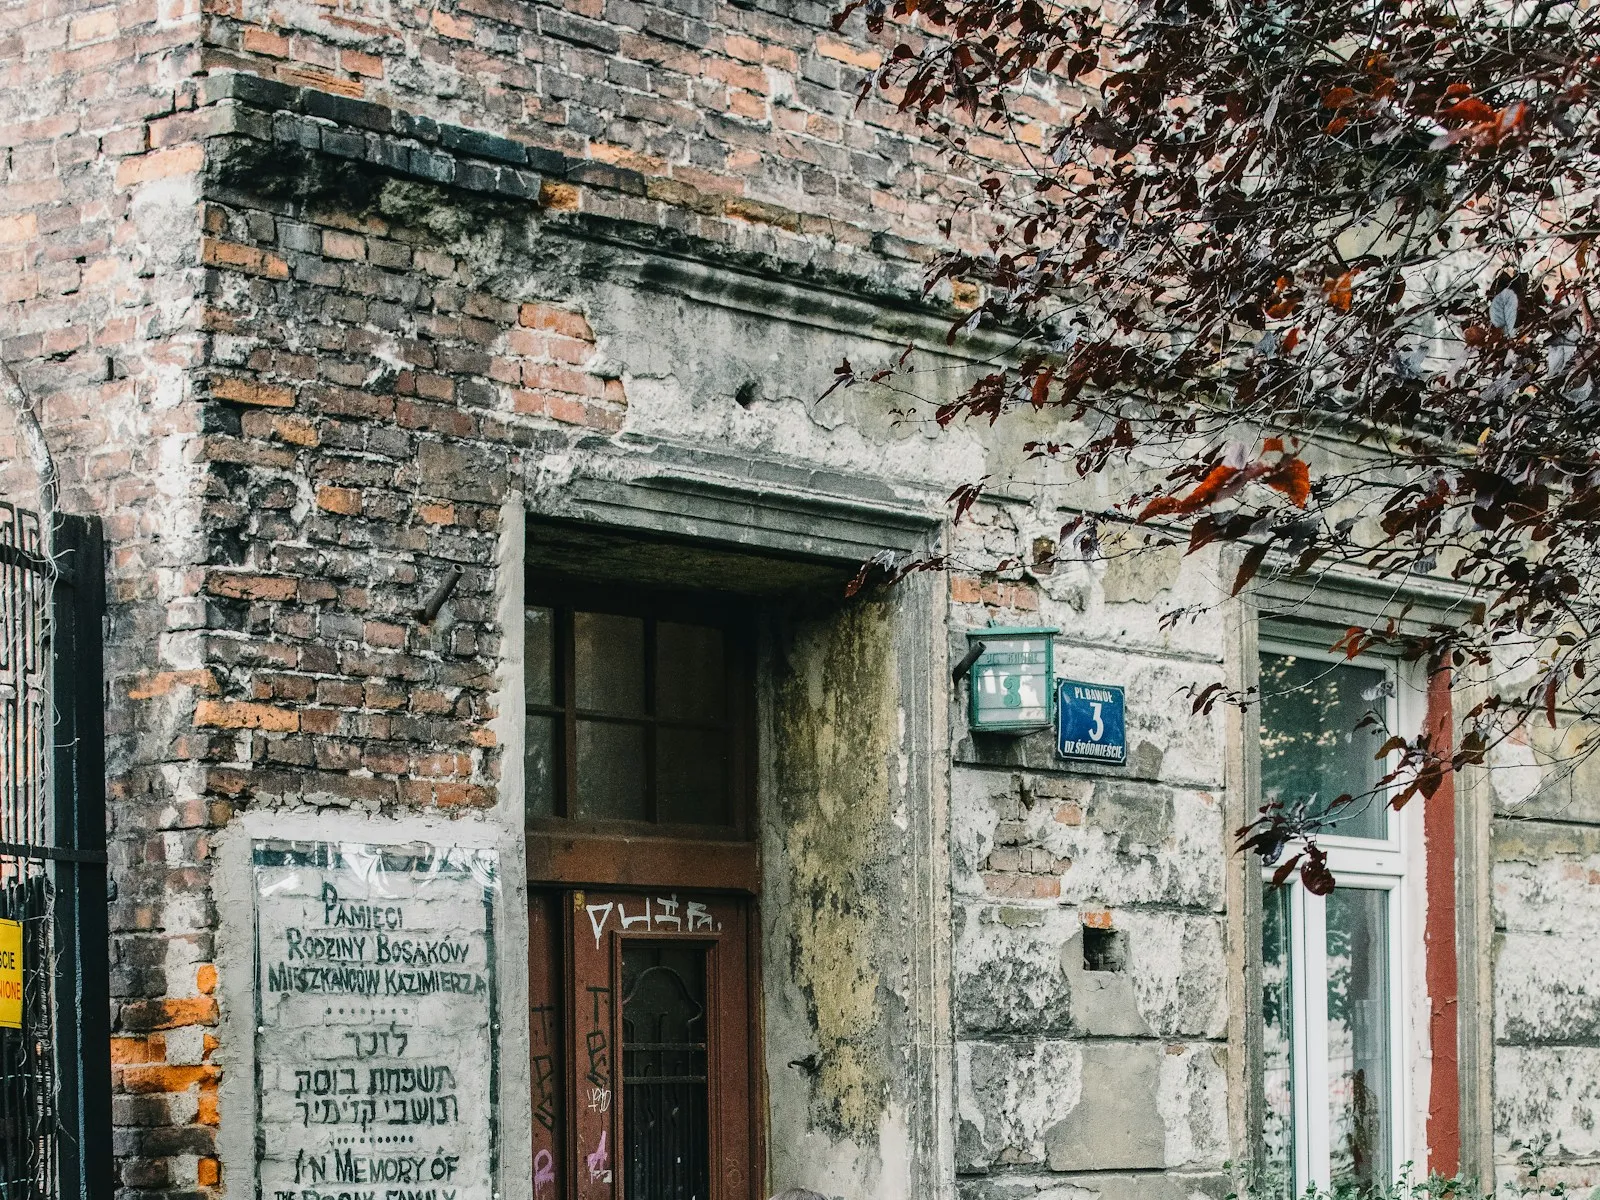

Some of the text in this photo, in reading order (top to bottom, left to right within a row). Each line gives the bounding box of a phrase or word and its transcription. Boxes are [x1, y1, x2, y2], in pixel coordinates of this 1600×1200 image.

[1088, 702, 1104, 741] 3
[286, 927, 470, 964] RODZINY BOSAKÓW
[385, 967, 487, 996] KAZIMIERZA
[344, 1020, 408, 1057] לזכר
[295, 1068, 359, 1099] בוסק
[295, 1149, 460, 1184] IN MEMORY OF
